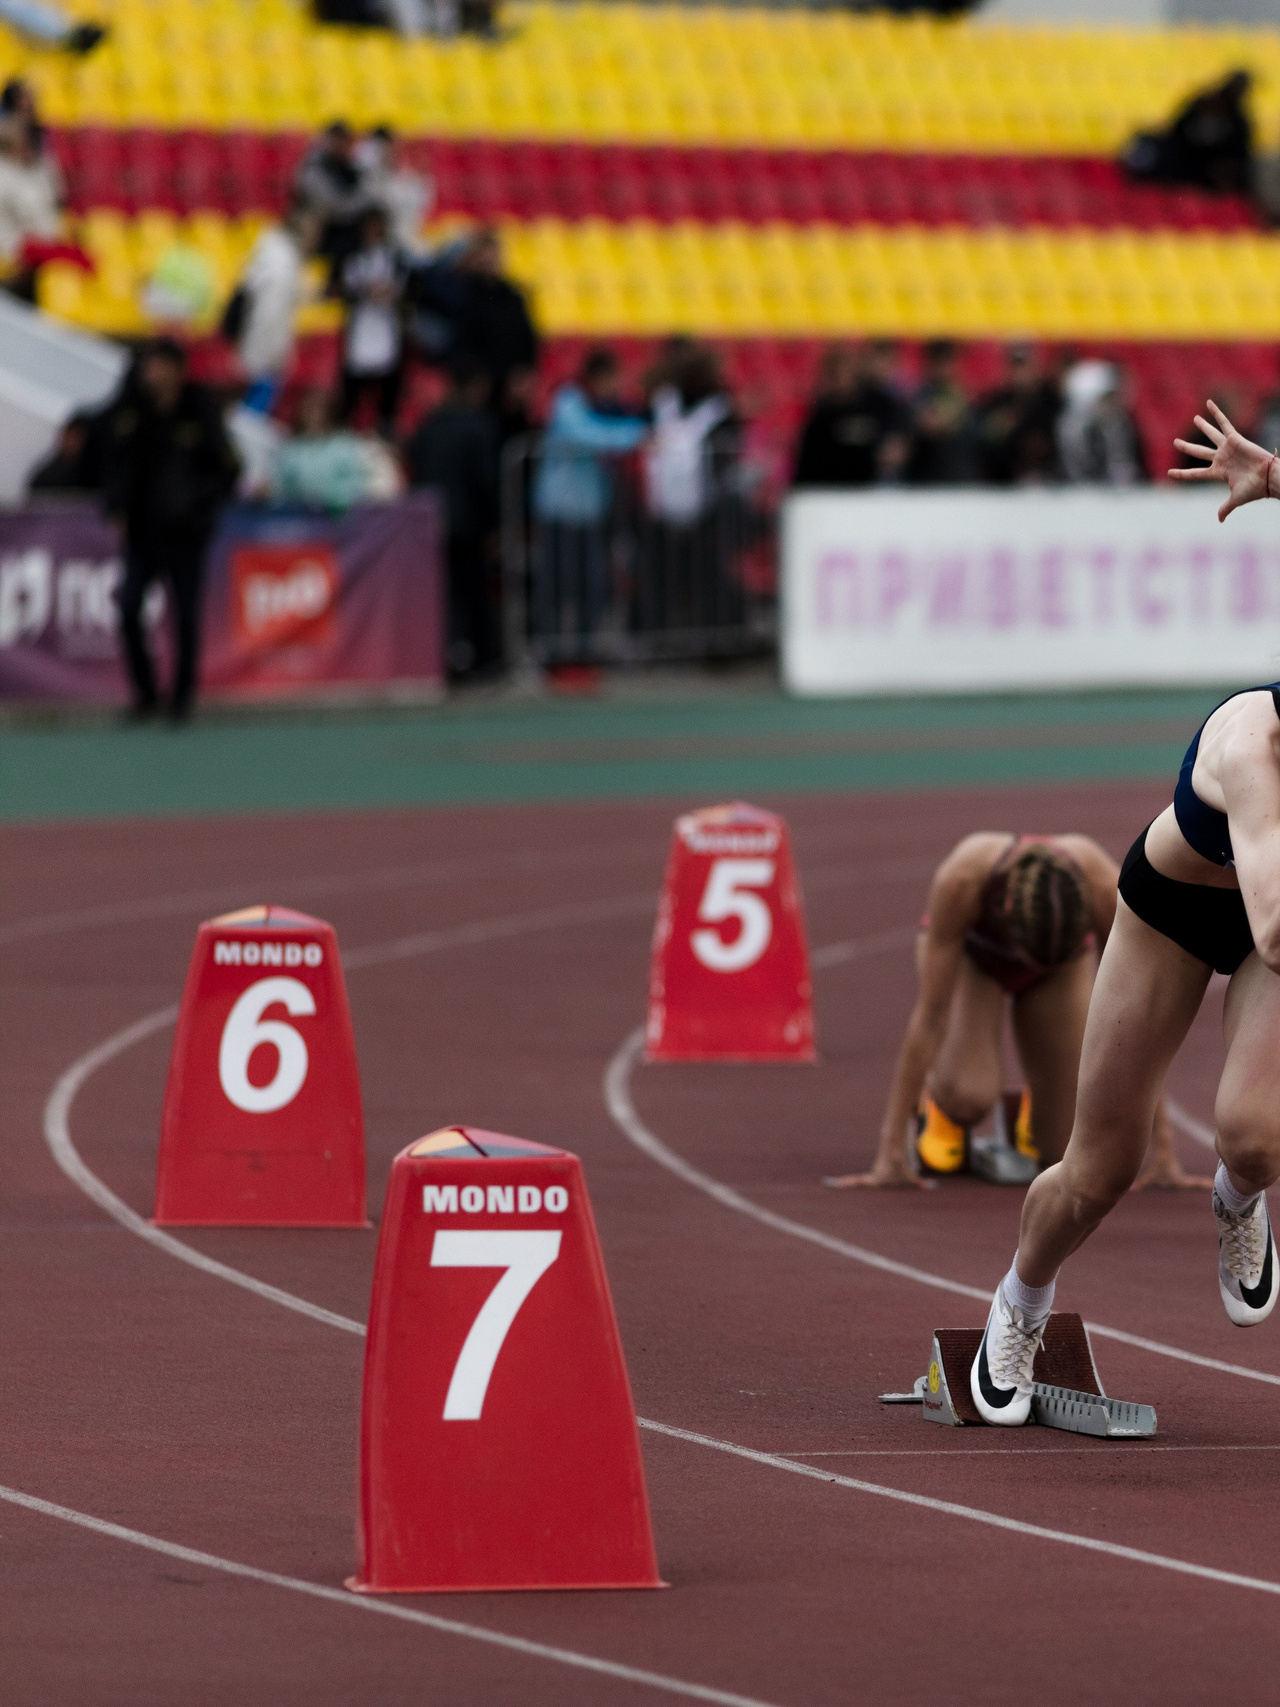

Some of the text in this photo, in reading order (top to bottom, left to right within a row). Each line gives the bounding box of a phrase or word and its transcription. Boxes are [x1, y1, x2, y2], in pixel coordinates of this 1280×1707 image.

[215, 942, 323, 967] MONDO
[691, 858, 775, 972] 5
[218, 976, 317, 1114] 6
[423, 1185, 569, 1213] MONDO
[430, 1230, 563, 1421] 7
